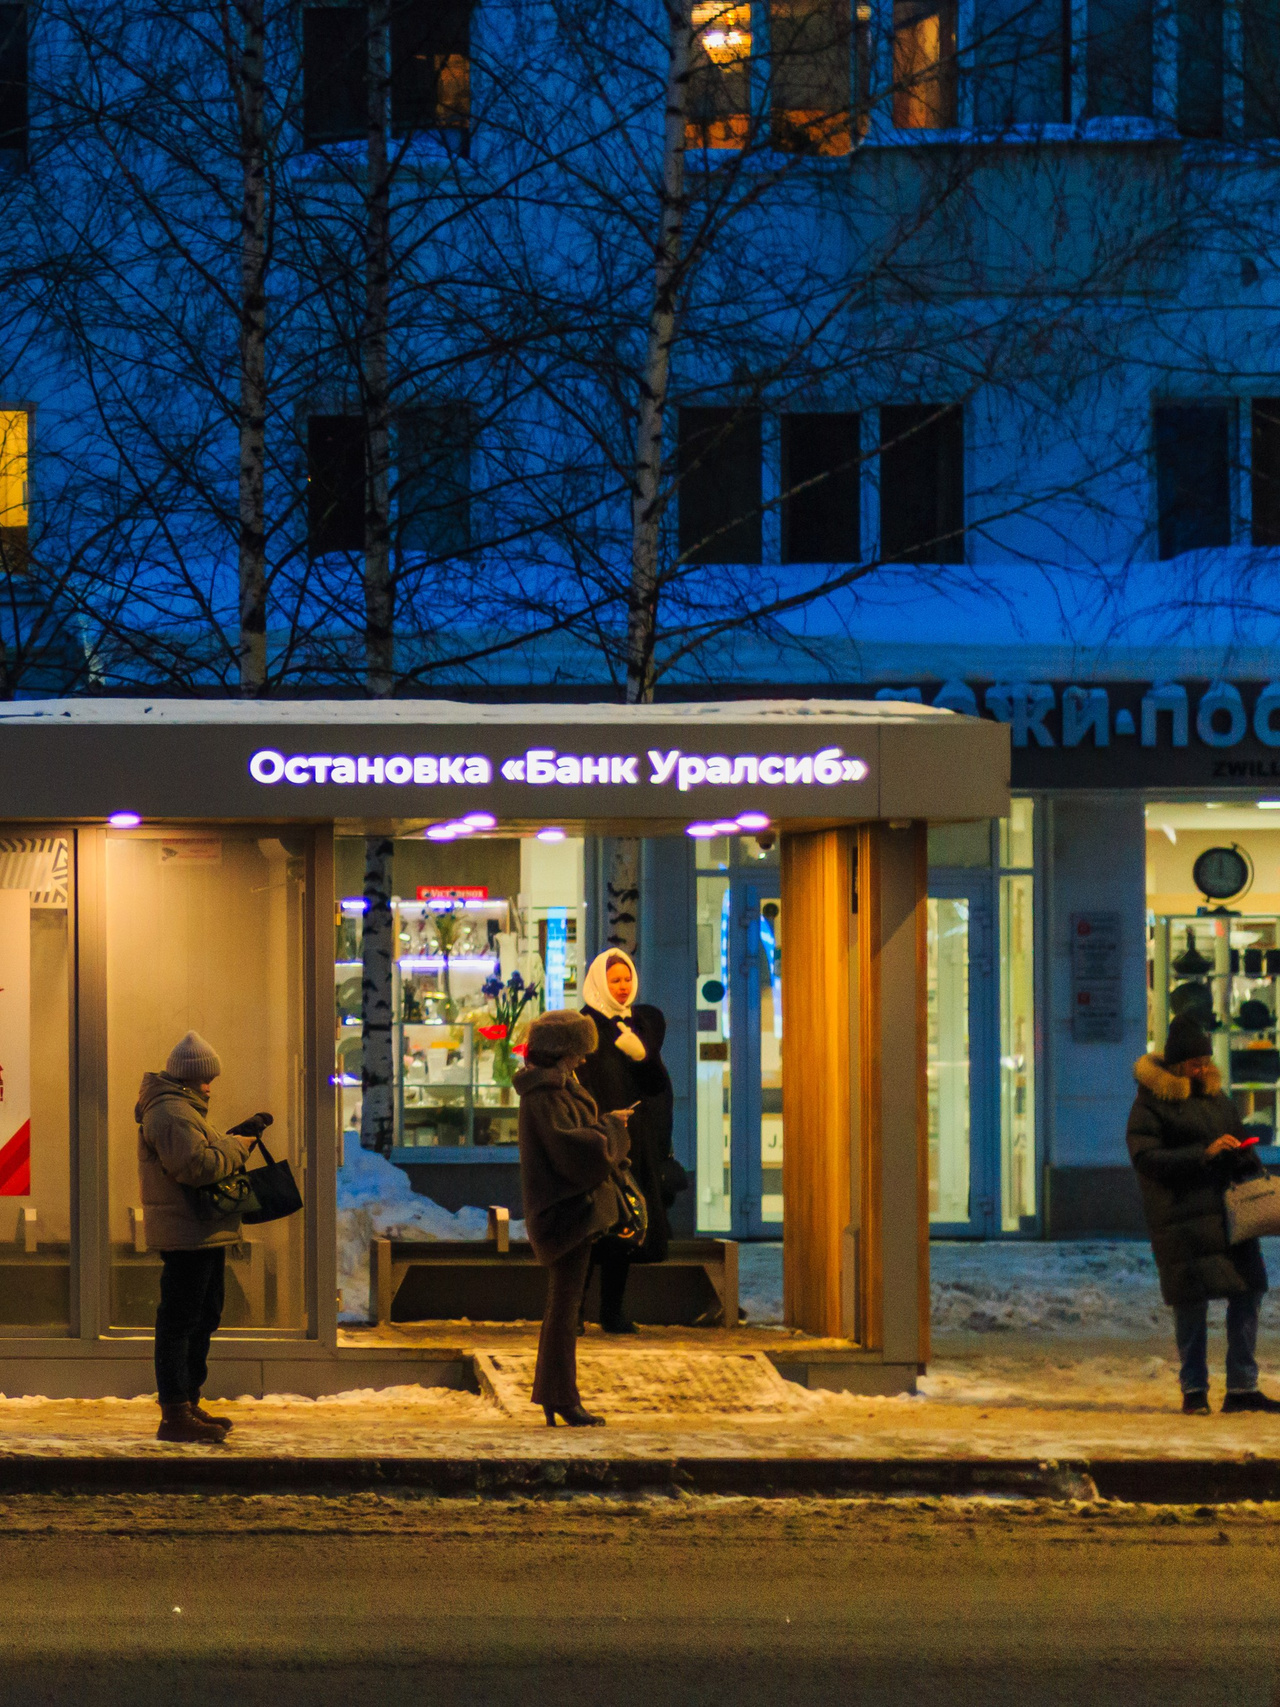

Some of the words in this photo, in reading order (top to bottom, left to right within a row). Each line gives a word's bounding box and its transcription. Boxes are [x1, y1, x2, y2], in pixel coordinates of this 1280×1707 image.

[249, 750, 491, 784] Остановка
[501, 750, 638, 784] «Банк
[647, 747, 868, 791] Уралсиб»
